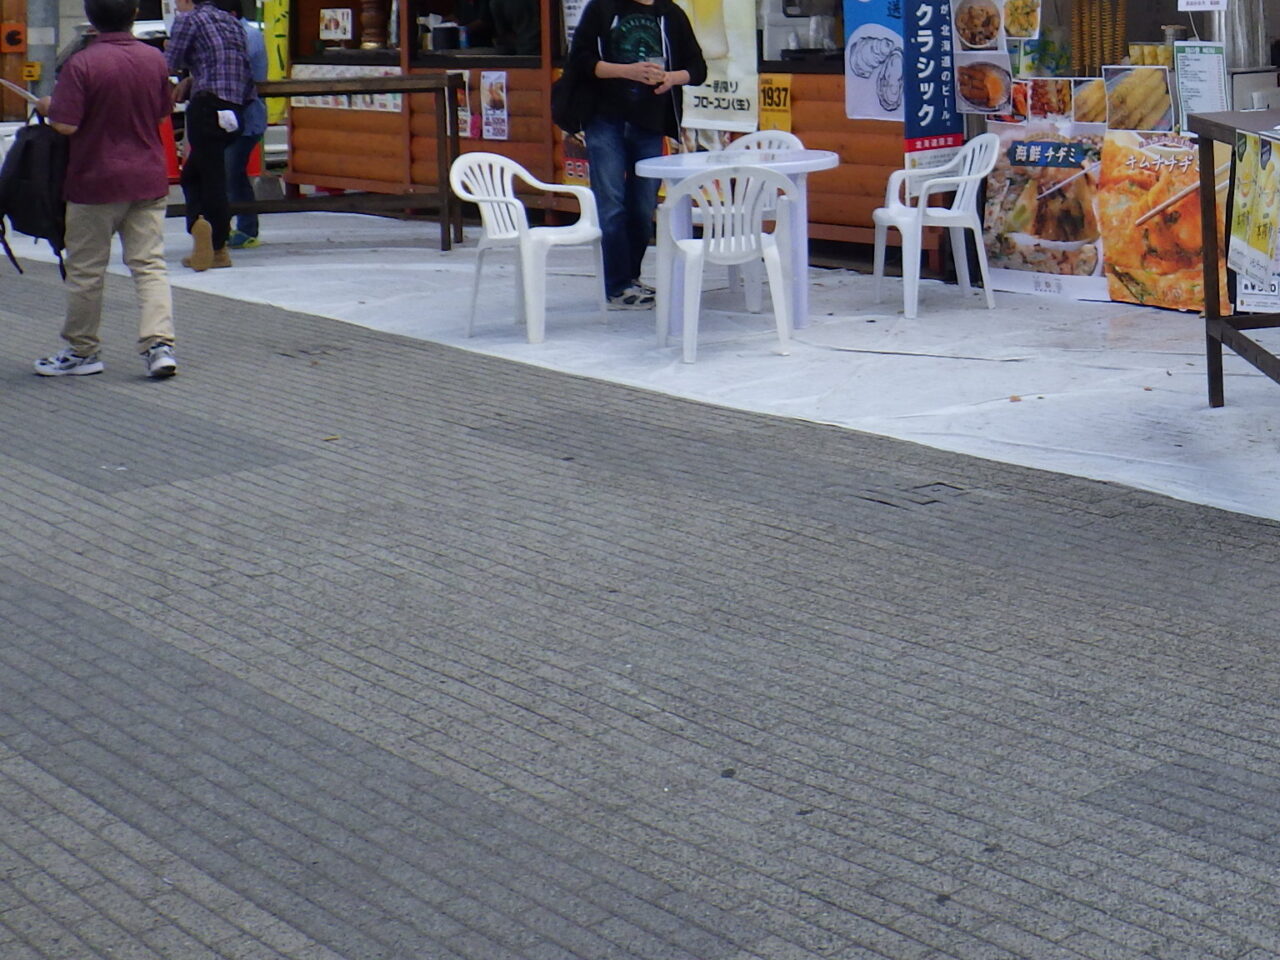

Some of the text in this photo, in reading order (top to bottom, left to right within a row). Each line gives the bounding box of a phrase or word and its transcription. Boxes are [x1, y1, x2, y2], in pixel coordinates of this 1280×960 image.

[761, 87, 788, 107] 1937
[916, 3, 935, 127] クラシック
